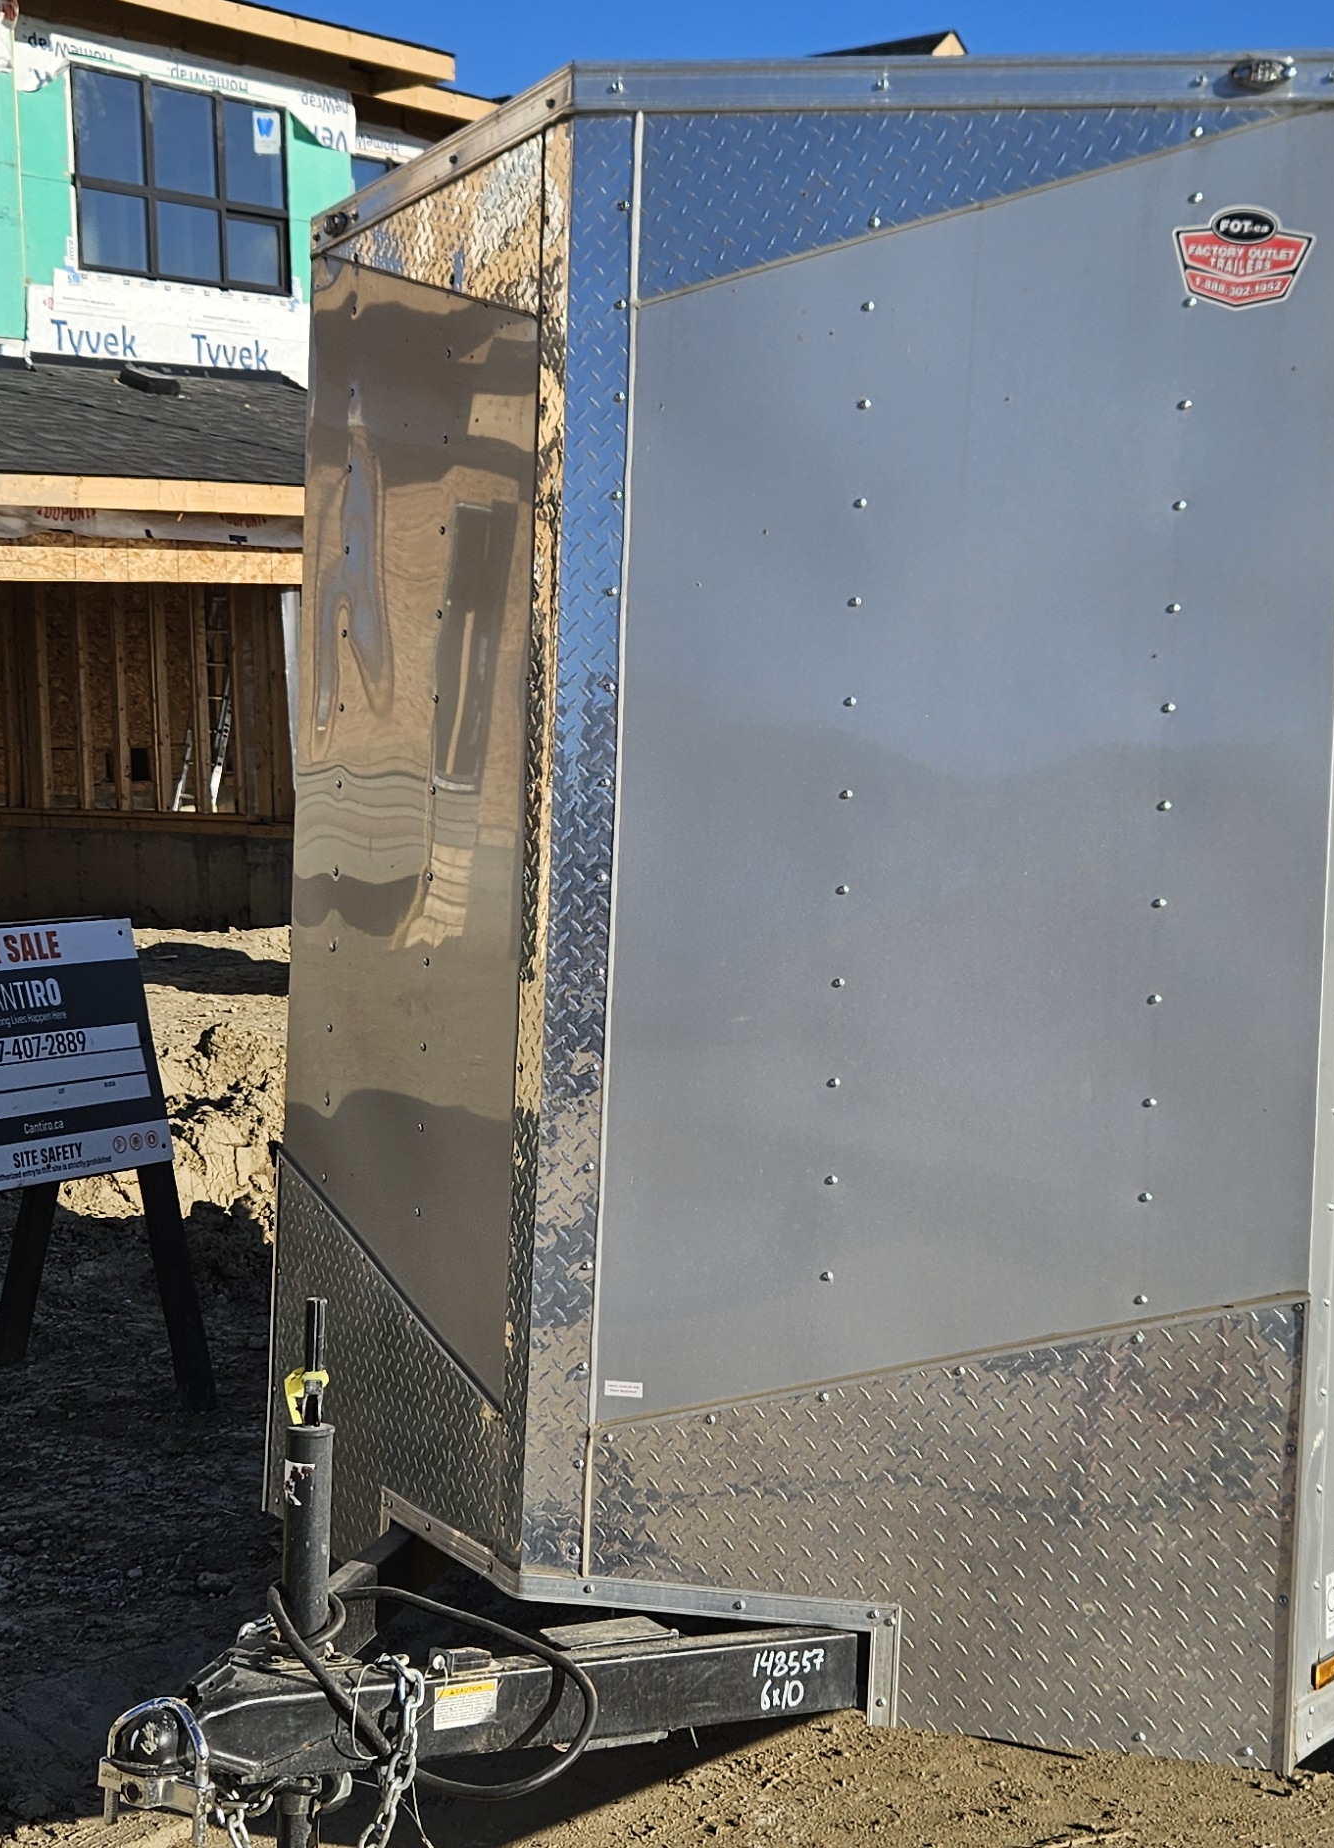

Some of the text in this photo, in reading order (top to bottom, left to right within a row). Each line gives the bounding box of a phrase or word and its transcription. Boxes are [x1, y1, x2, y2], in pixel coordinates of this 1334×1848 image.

[1188, 244, 1295, 260] FACTORY OUTLET
[1210, 258, 1271, 276] TRAILERS
[50, 319, 137, 359] Tyvek
[191, 333, 269, 371] Tyvek
[3, 930, 62, 963] SALE
[11, 1014, 27, 1025] Lives
[27, 1011, 52, 1024] Happen
[52, 1010, 67, 1020] Here
[23, 1119, 65, 1135] Cantiro.ca
[12, 1141, 83, 1169] SITE SAFETY
[22, 1168, 36, 1178] entry
[51, 1164, 62, 1173] site
[67, 1161, 86, 1170] strictly
[86, 1155, 112, 1168] prohibited
[752, 1648, 825, 1678] 148557
[455, 1686, 483, 1694] CAUTION
[760, 1679, 805, 1711] 6x10
